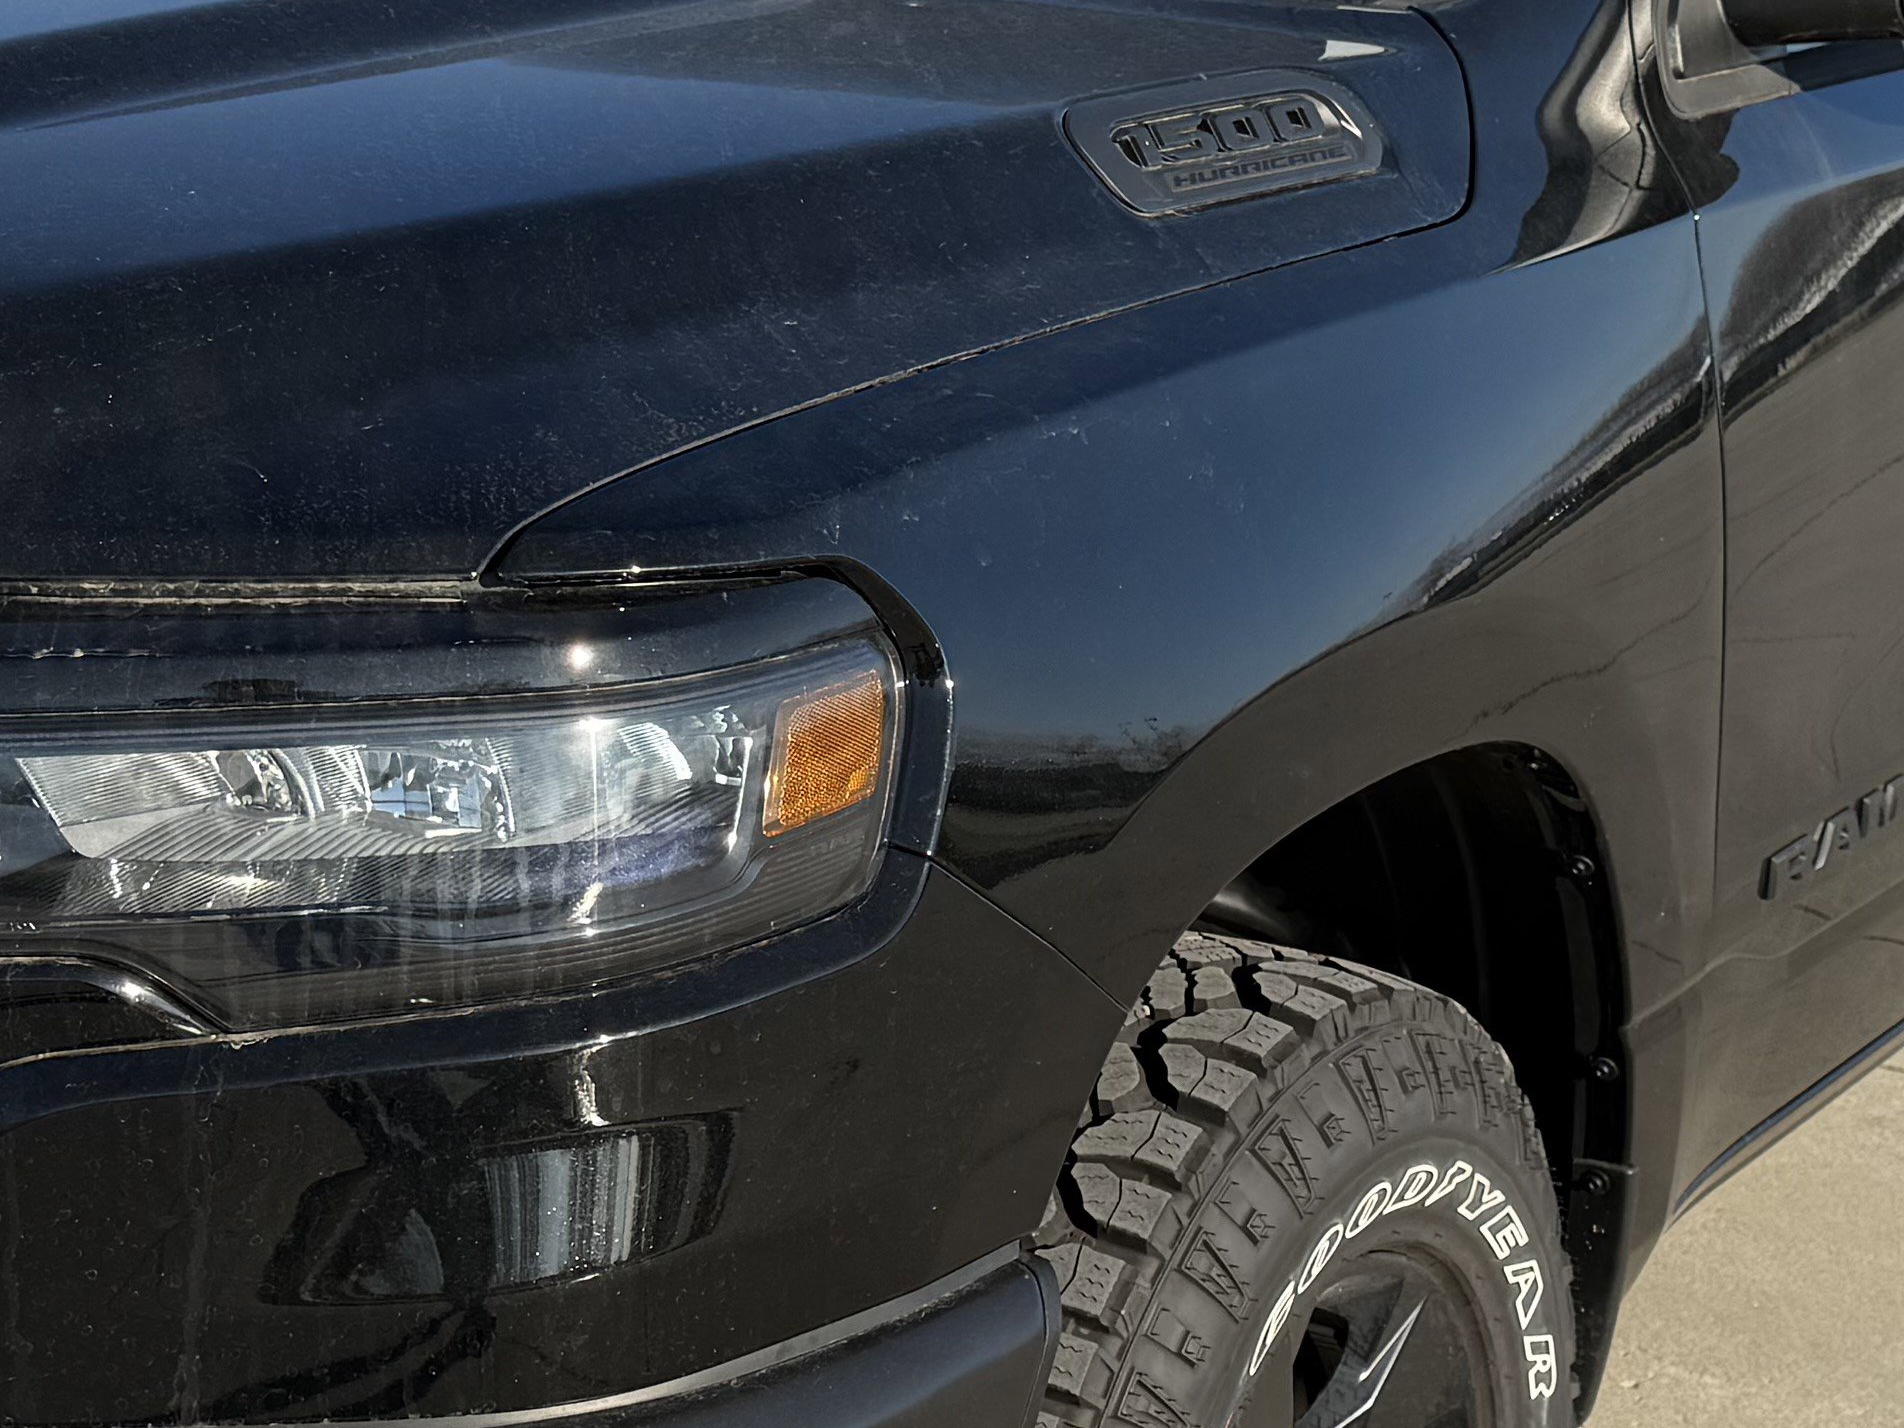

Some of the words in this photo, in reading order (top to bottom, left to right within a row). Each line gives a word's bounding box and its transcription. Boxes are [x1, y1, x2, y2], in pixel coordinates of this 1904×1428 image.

[1112, 96, 1327, 171] 1500
[1173, 145, 1346, 188] HURRICANE
[1247, 1158, 1559, 1401] GOODYEAR
